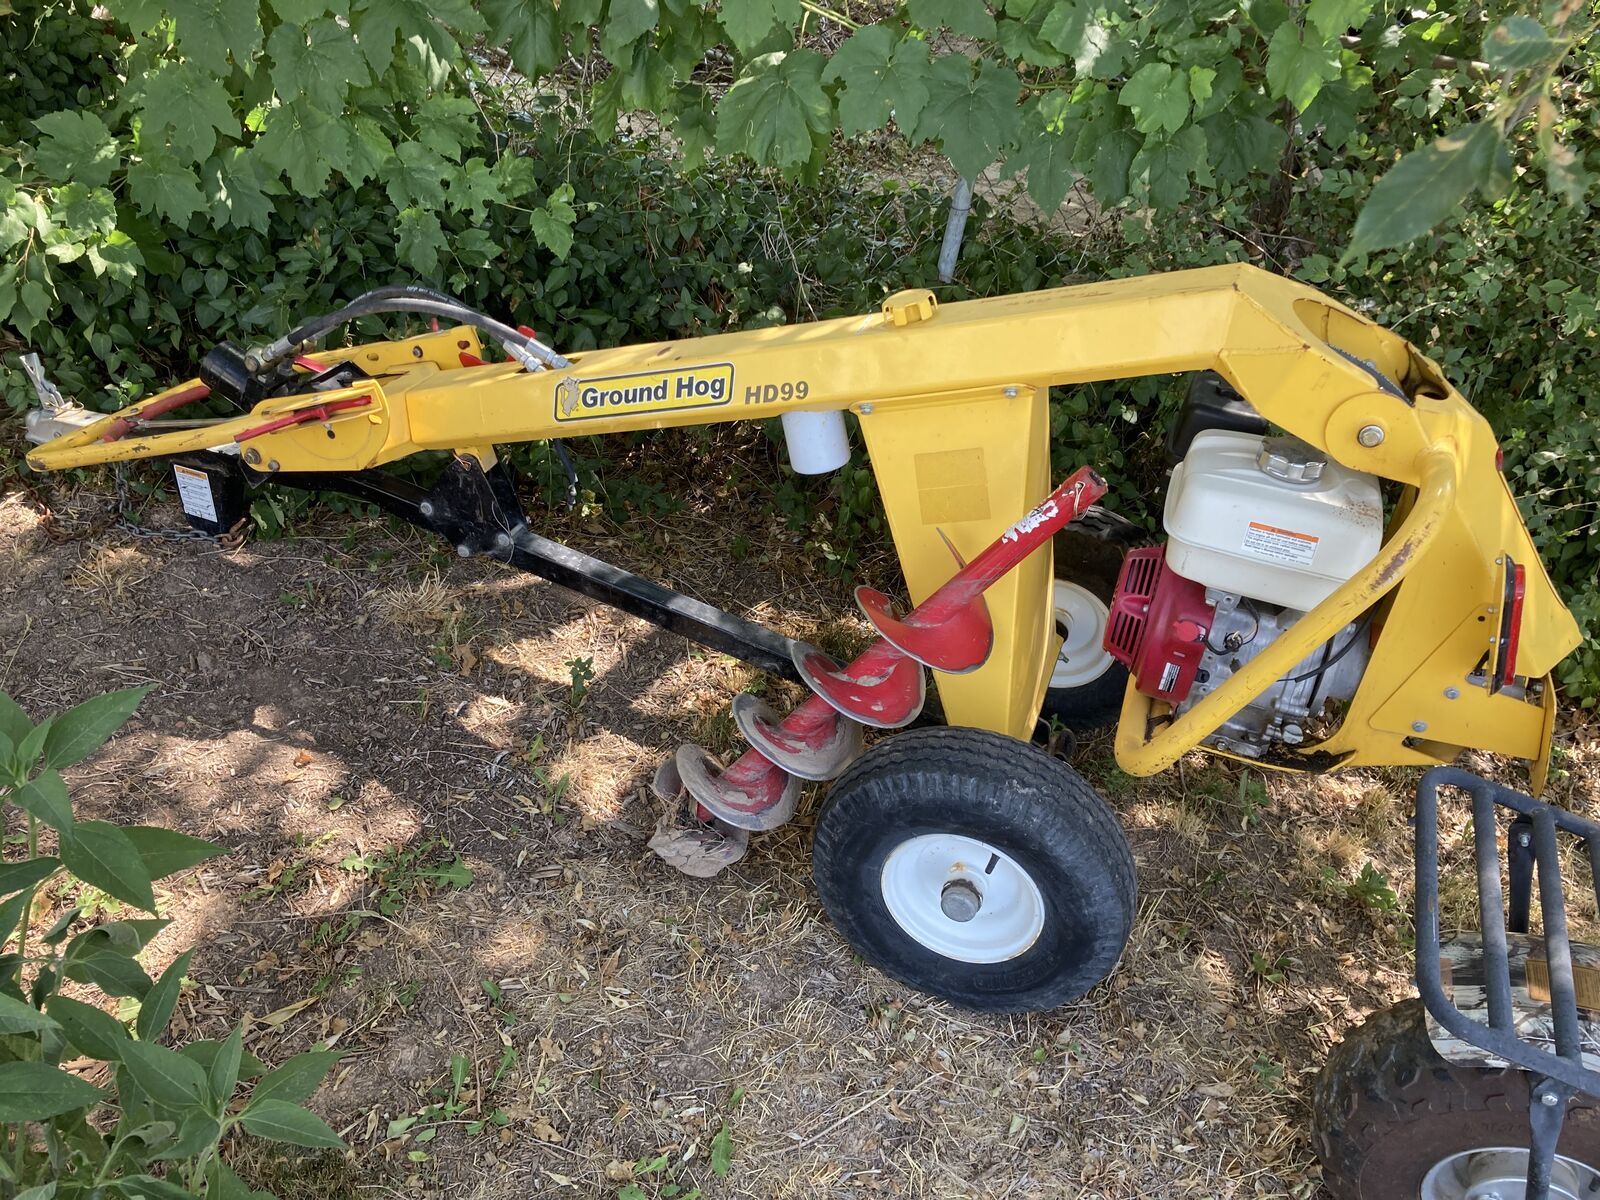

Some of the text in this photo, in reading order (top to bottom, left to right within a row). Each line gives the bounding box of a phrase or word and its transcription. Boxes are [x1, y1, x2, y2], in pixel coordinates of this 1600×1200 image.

[581, 375, 726, 408] Ground Hog
[744, 380, 810, 405] HD99
